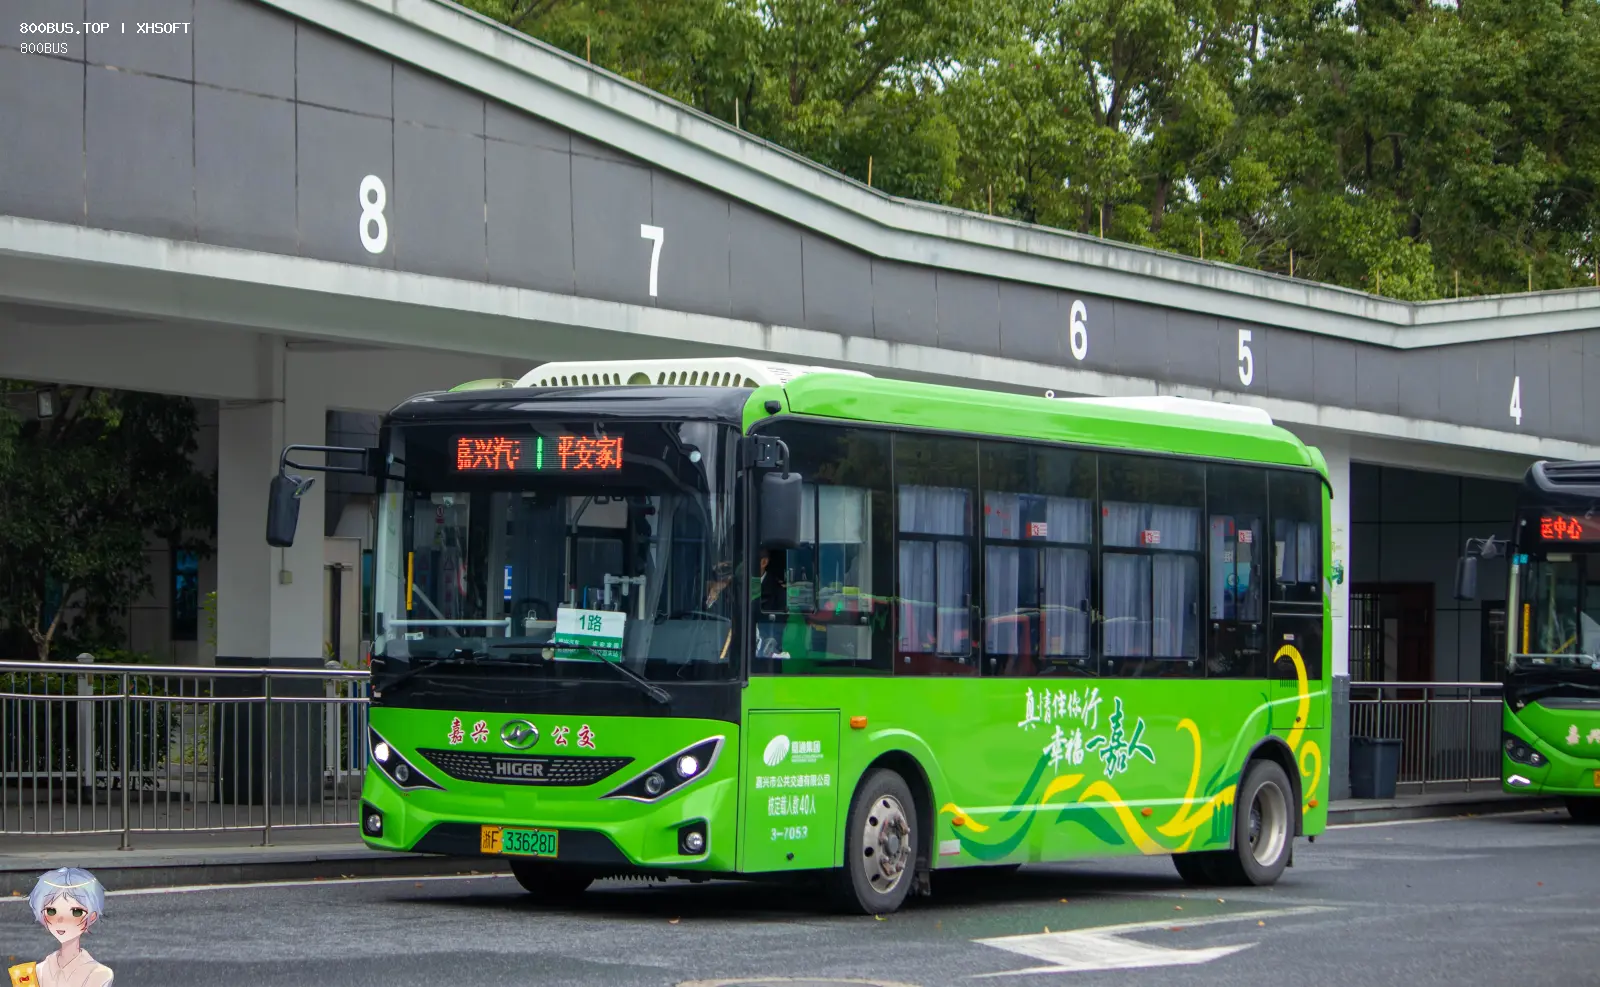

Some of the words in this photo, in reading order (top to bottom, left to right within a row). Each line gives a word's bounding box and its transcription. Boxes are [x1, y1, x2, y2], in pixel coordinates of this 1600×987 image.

[359, 174, 388, 253] 8
[640, 224, 664, 297] 7
[1069, 299, 1088, 361] 6
[1238, 328, 1254, 386] 5
[1509, 375, 1522, 426] 4
[579, 614, 602, 632] 1路
[448, 717, 490, 745] 嘉兴
[551, 724, 596, 749] 公交
[496, 762, 544, 777] HIGER
[755, 774, 831, 789] 嘉兴市公共交通有限公司
